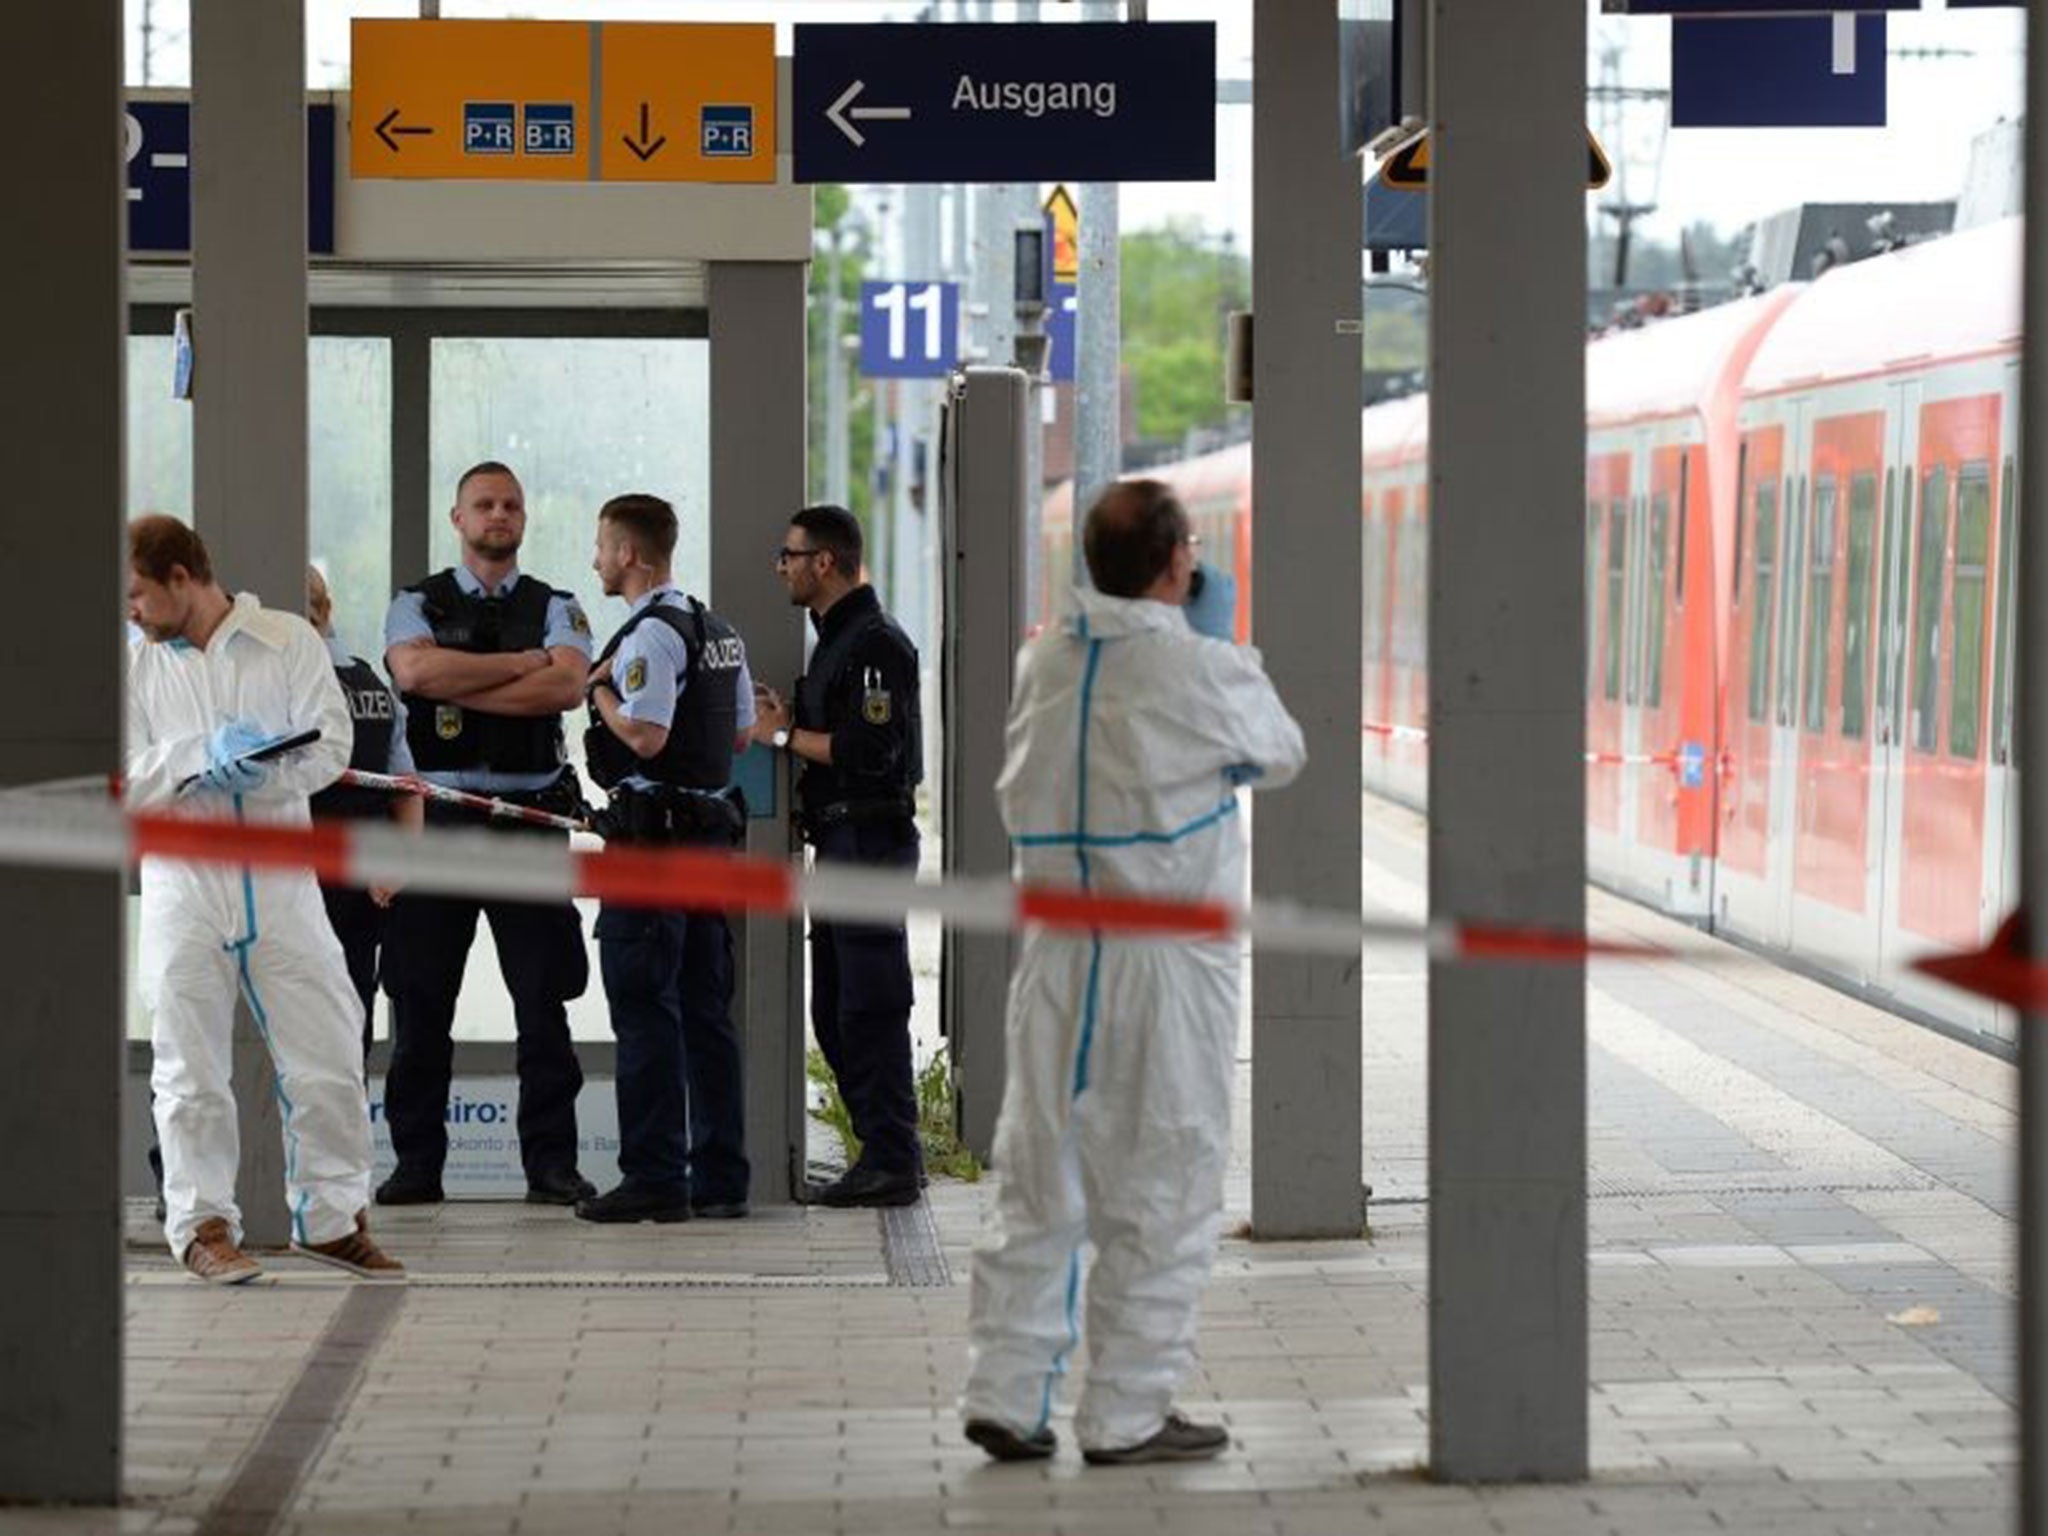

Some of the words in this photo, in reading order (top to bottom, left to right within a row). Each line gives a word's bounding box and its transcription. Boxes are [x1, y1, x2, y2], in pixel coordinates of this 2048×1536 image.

[952, 75, 1117, 117] Ausgang
[872, 283, 942, 360] 11
[444, 1097, 507, 1123] iro:
